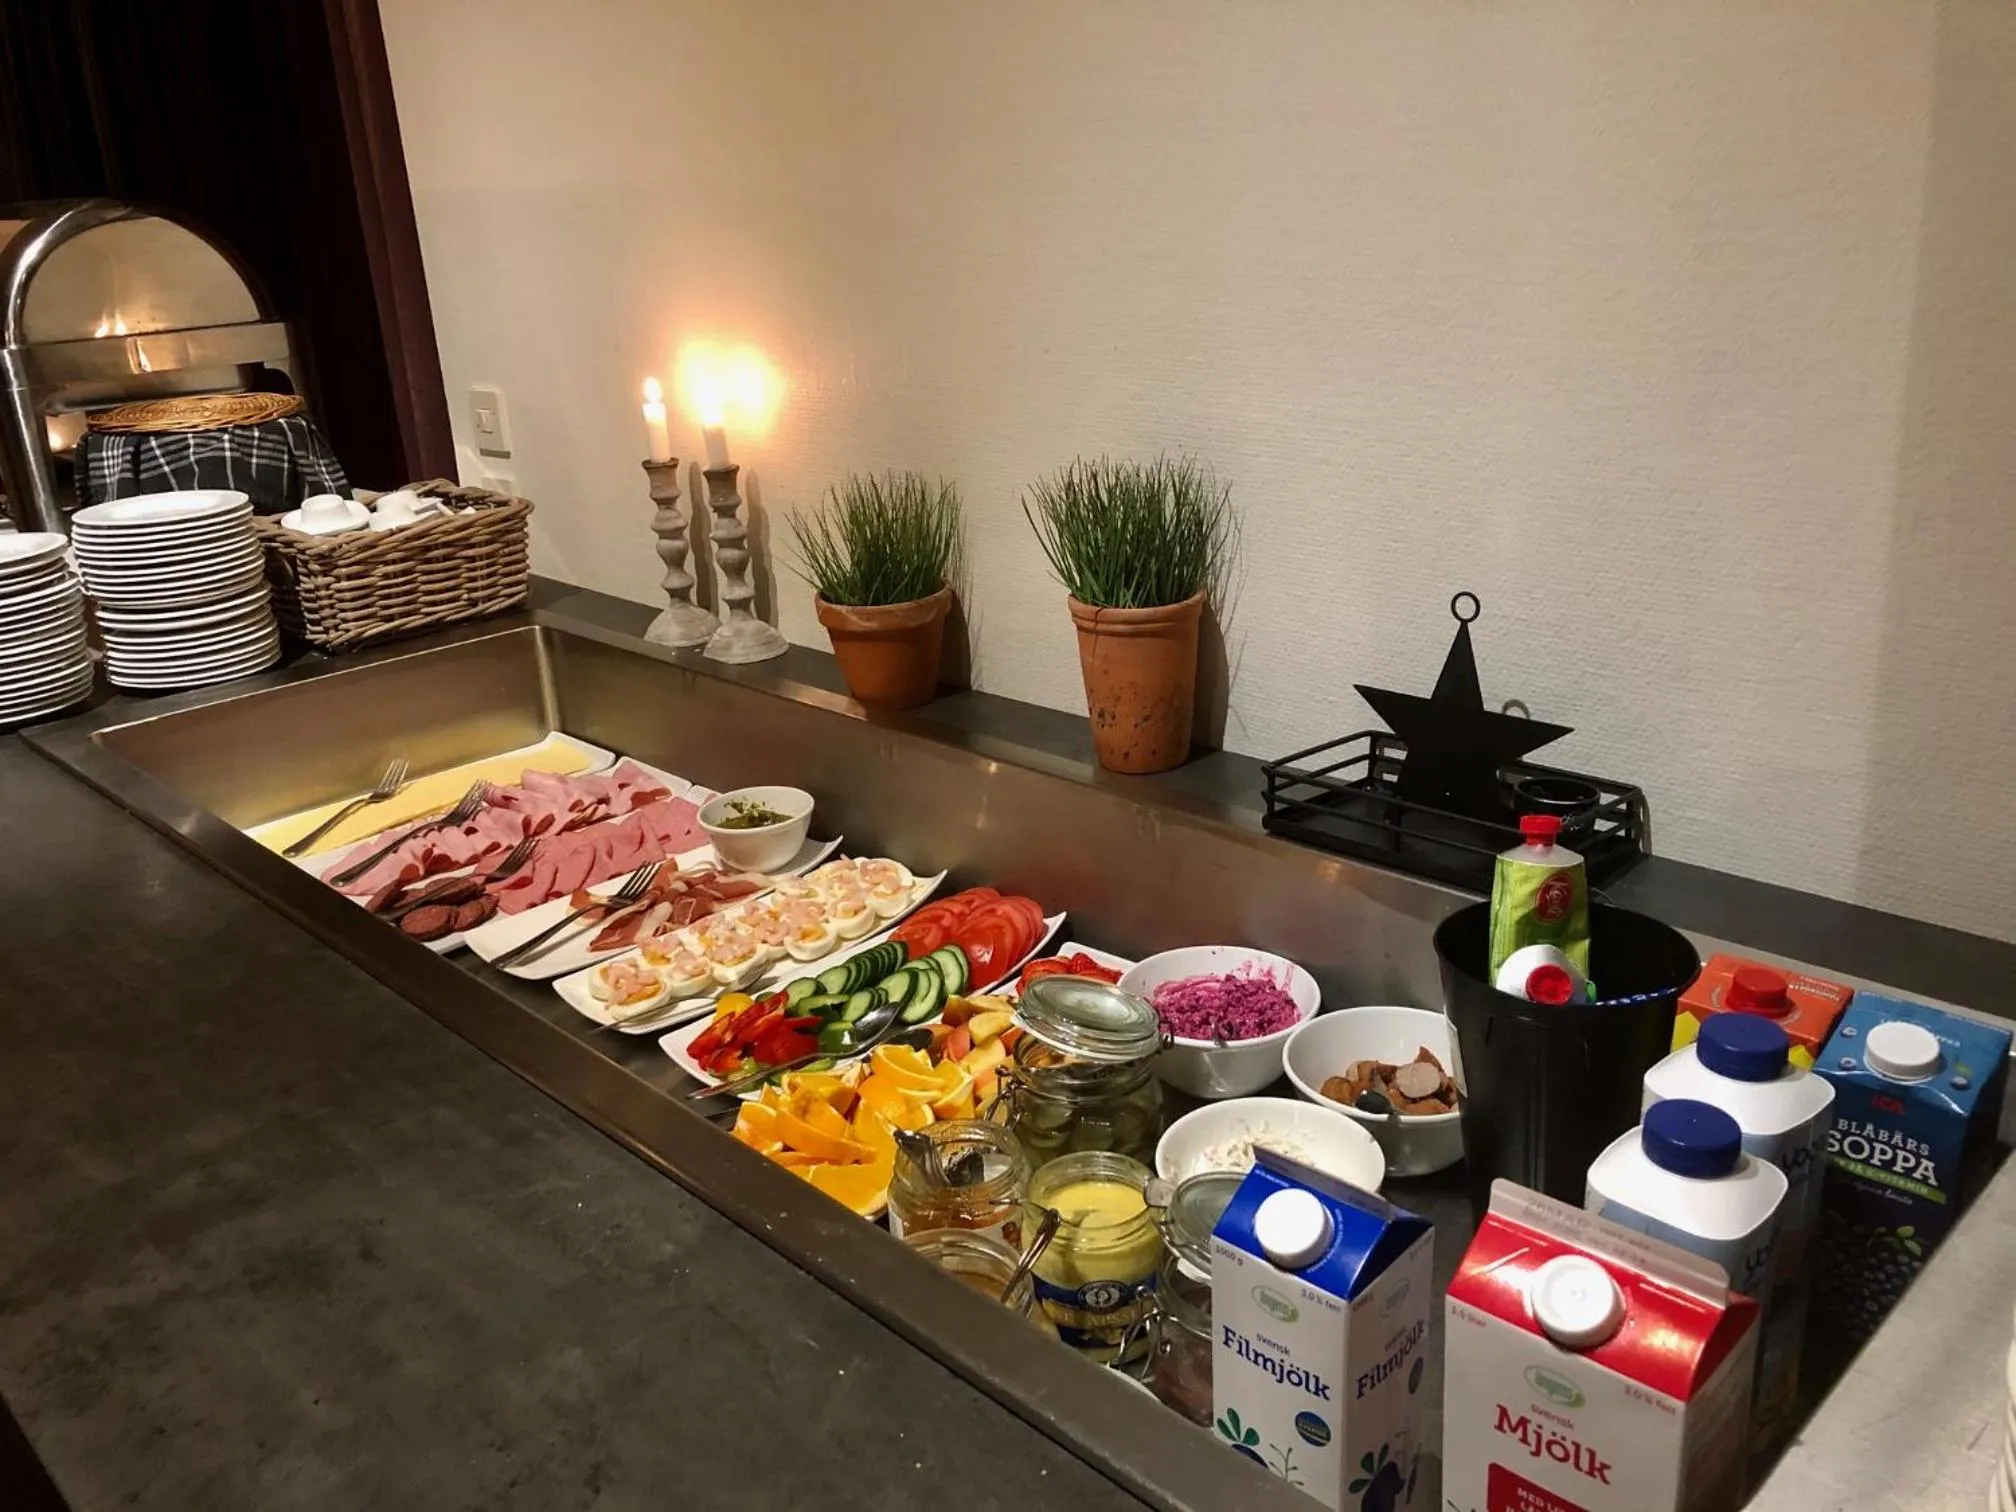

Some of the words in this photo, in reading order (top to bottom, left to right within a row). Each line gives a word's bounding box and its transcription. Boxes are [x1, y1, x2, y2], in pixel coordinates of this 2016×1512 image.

[1872, 1096, 1904, 1115] ICA
[1827, 1130, 1938, 1187] SOPPA
[1838, 1118, 1930, 1156] BLÅBÄRS
[1222, 1325, 1331, 1402] Filmjölk
[1256, 1332, 1291, 1356] svensk
[1356, 1319, 1425, 1400] Filmjölk
[1531, 1403, 1575, 1430] svensk
[1494, 1403, 1612, 1486] Mjölk
